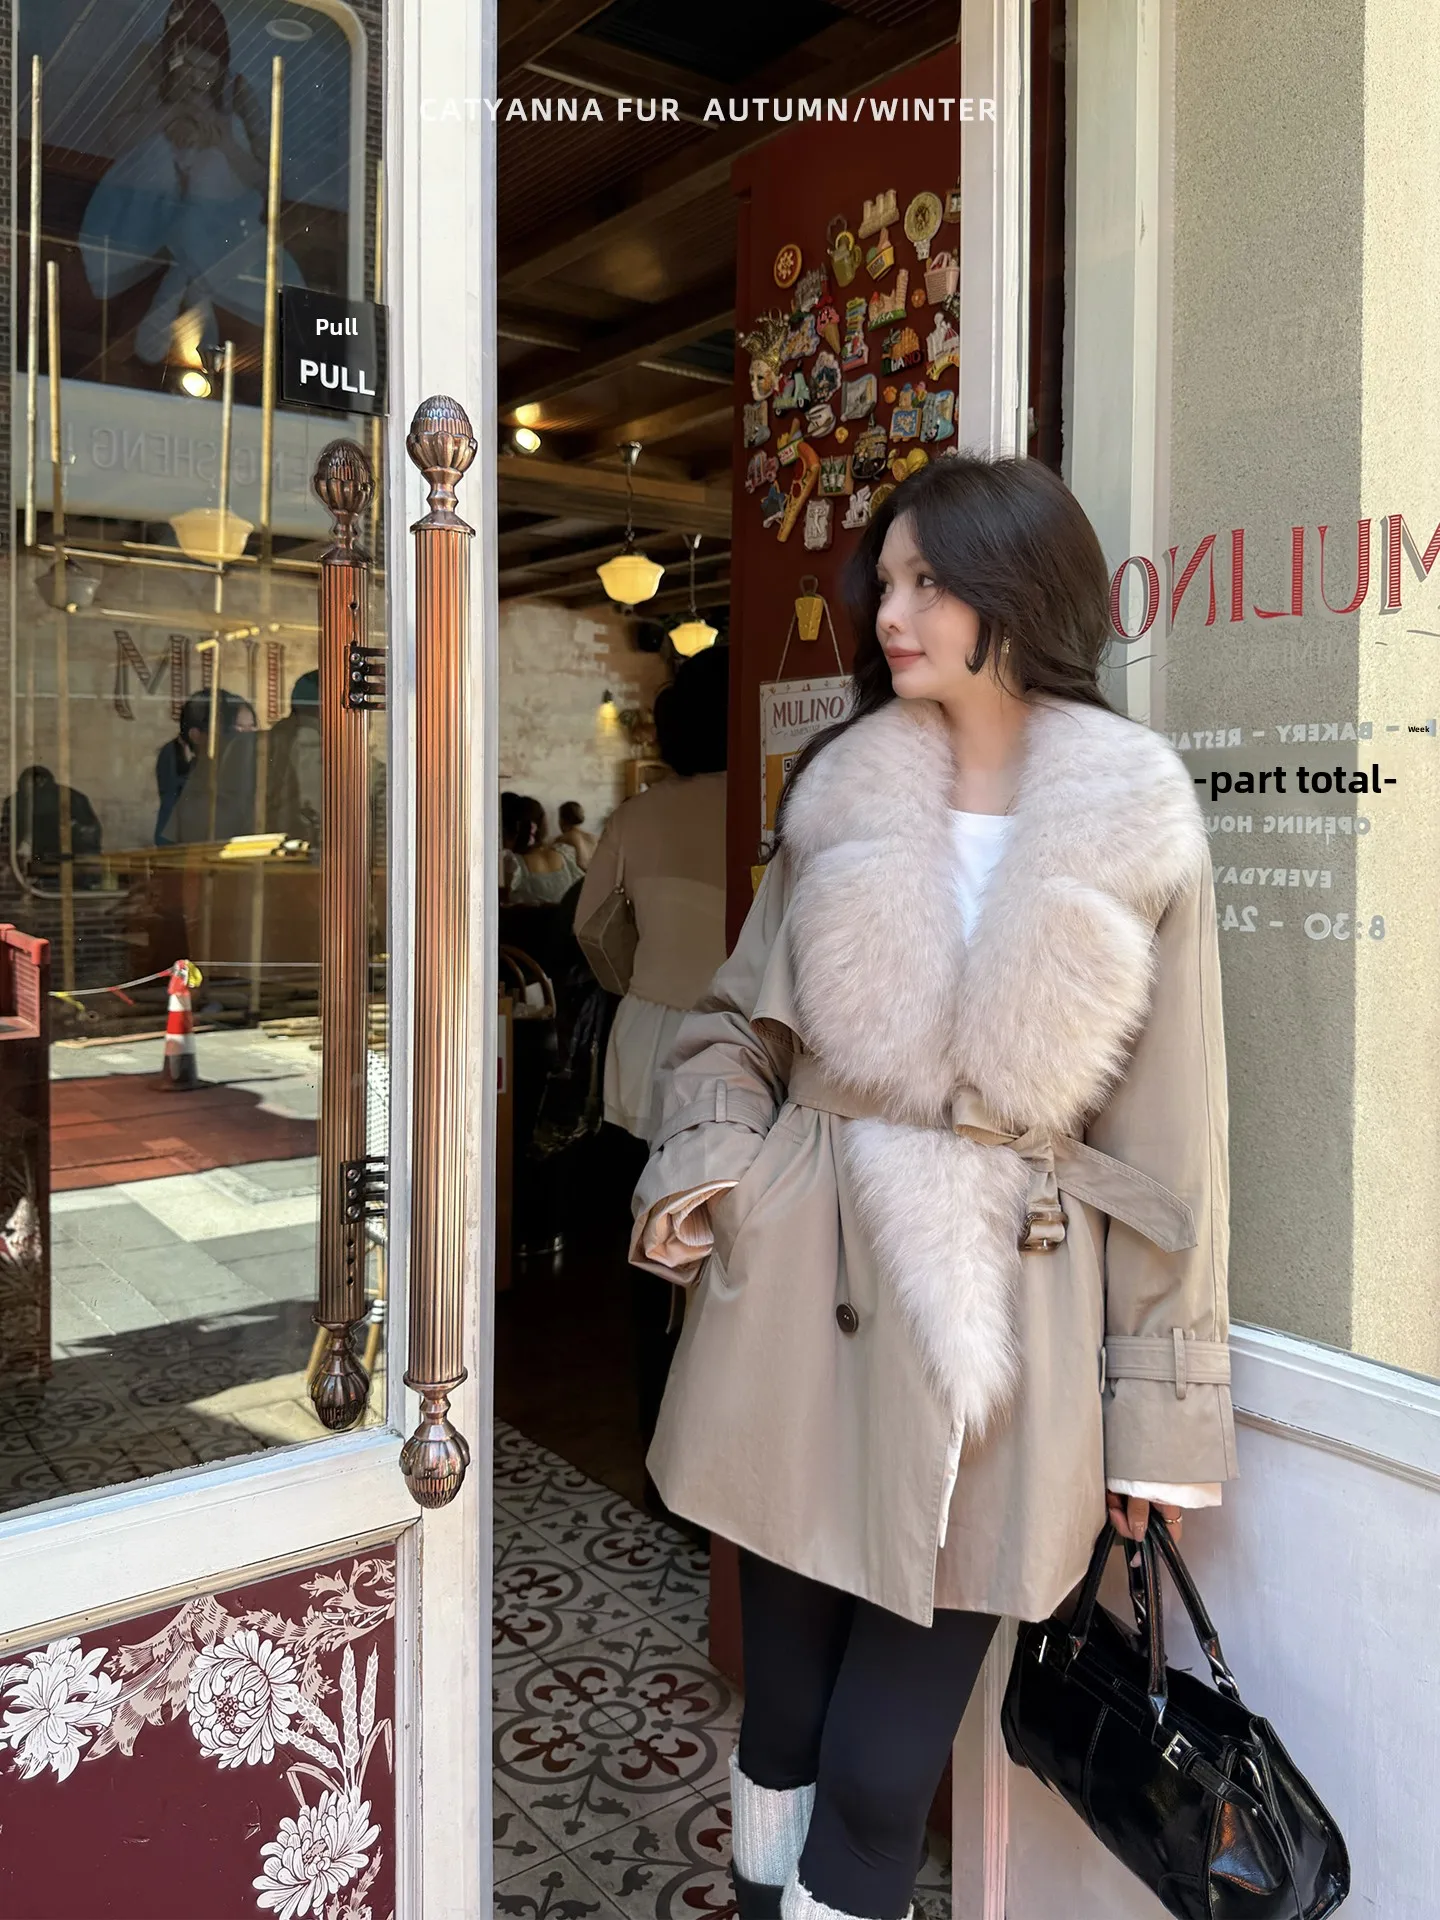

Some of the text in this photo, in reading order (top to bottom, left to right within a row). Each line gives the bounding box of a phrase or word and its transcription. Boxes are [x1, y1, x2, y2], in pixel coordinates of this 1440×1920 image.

[315, 317, 358, 336] Pull
[299, 358, 376, 396] PULL
[773, 696, 845, 729] MULINO
